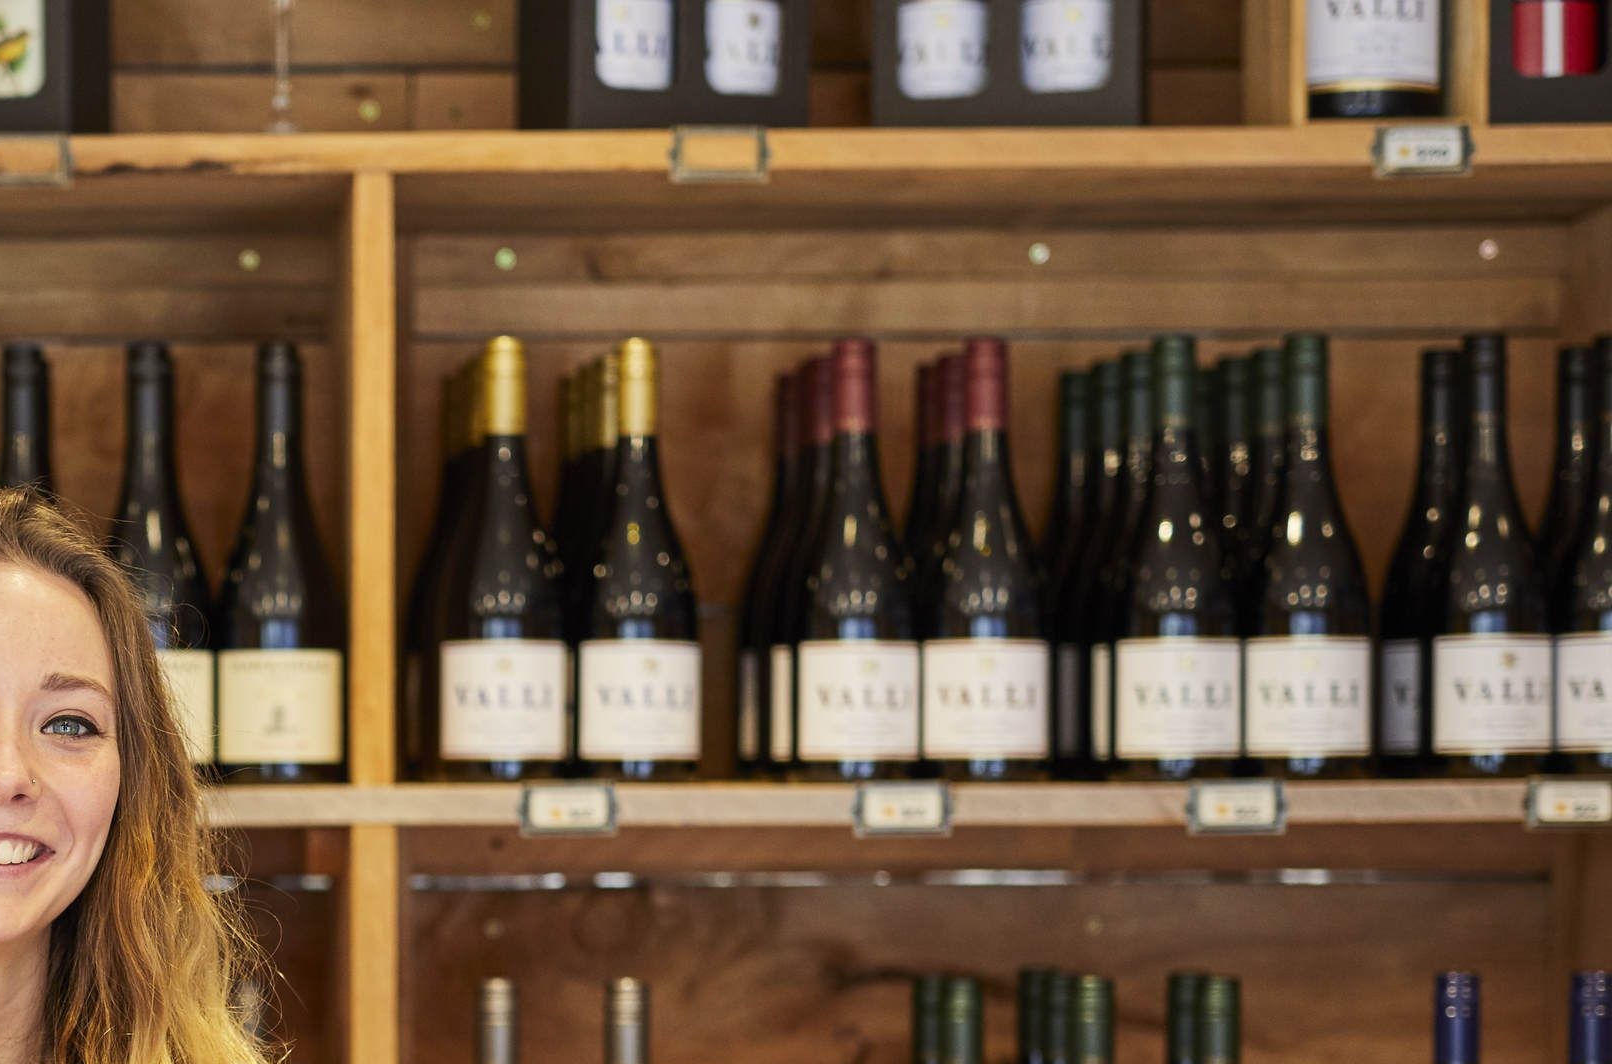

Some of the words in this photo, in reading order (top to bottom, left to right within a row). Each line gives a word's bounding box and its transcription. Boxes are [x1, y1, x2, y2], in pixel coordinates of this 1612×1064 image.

[1325, 0, 1426, 22] VALLI
[453, 680, 554, 709] VALLI
[595, 681, 694, 710] VALLI
[815, 683, 913, 709] VALLI
[935, 682, 1038, 709] VALLI
[1132, 682, 1231, 708] VALLI
[1257, 682, 1361, 708] VALLI
[1452, 677, 1548, 704] VALLI
